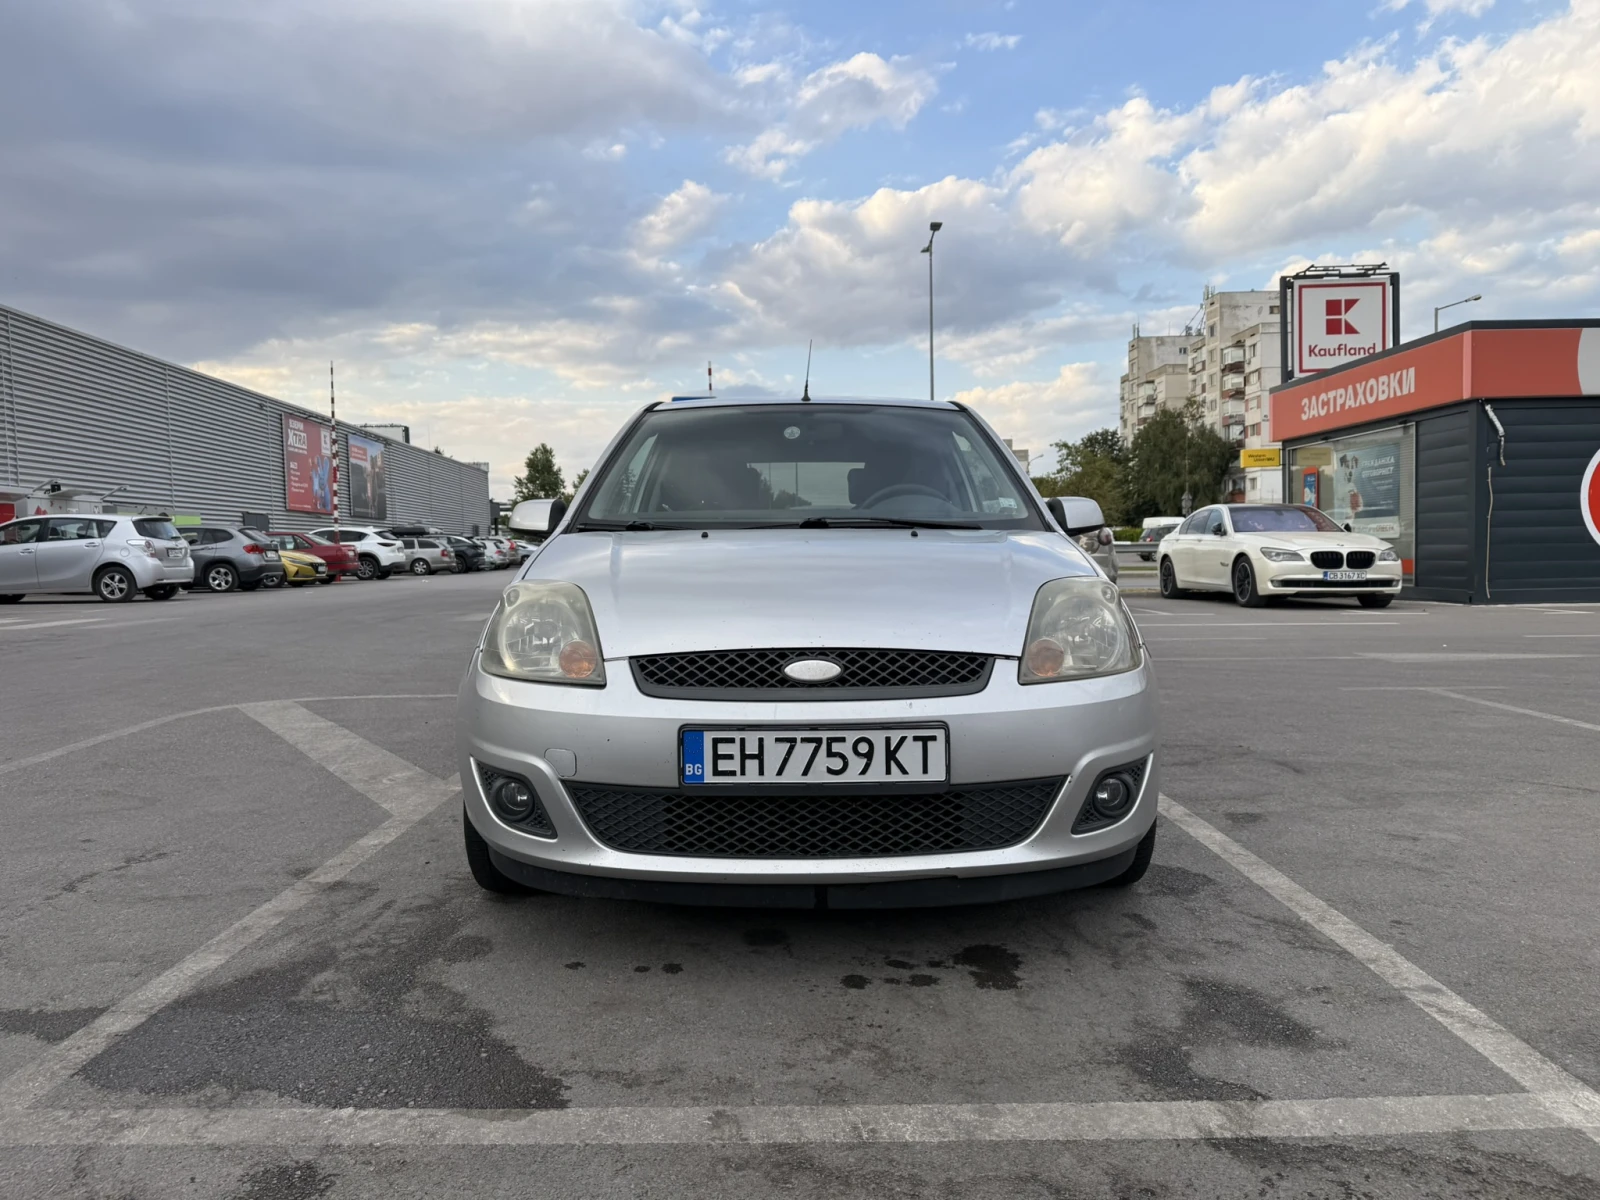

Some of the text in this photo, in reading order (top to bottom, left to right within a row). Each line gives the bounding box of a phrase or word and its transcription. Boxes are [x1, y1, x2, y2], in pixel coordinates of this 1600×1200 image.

[1308, 343, 1376, 358] Kaufland
[1301, 367, 1415, 421] ЗАСТРАХОВКИ
[685, 763, 703, 776] BG
[712, 735, 938, 777] EH 7759 KT
